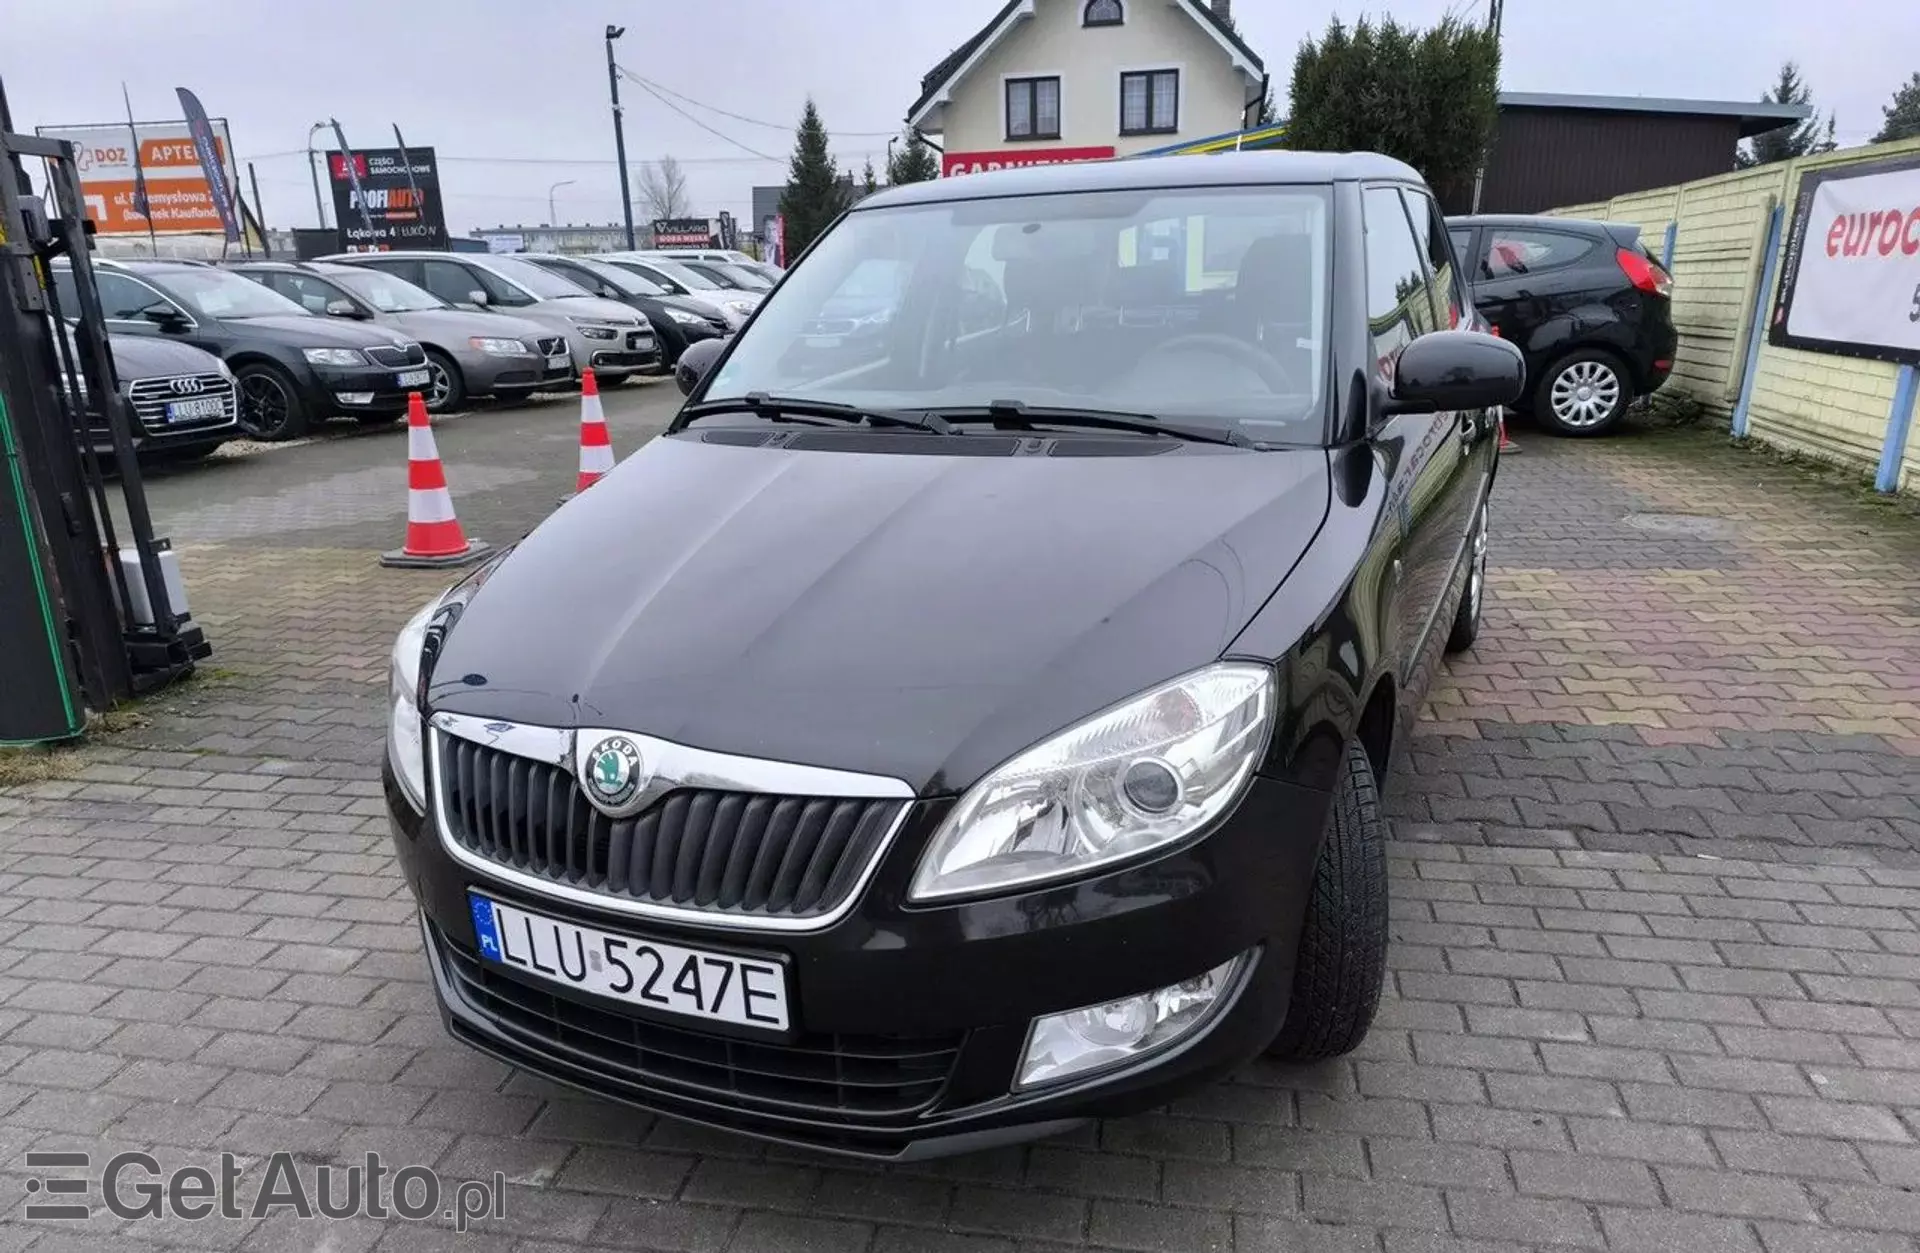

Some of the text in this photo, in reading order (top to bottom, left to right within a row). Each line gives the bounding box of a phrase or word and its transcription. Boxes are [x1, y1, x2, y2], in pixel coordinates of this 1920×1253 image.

[95, 148, 127, 162] DOZ
[151, 144, 200, 161] APTE
[481, 934, 499, 953] PL
[496, 907, 780, 1025] LLU 5247E
